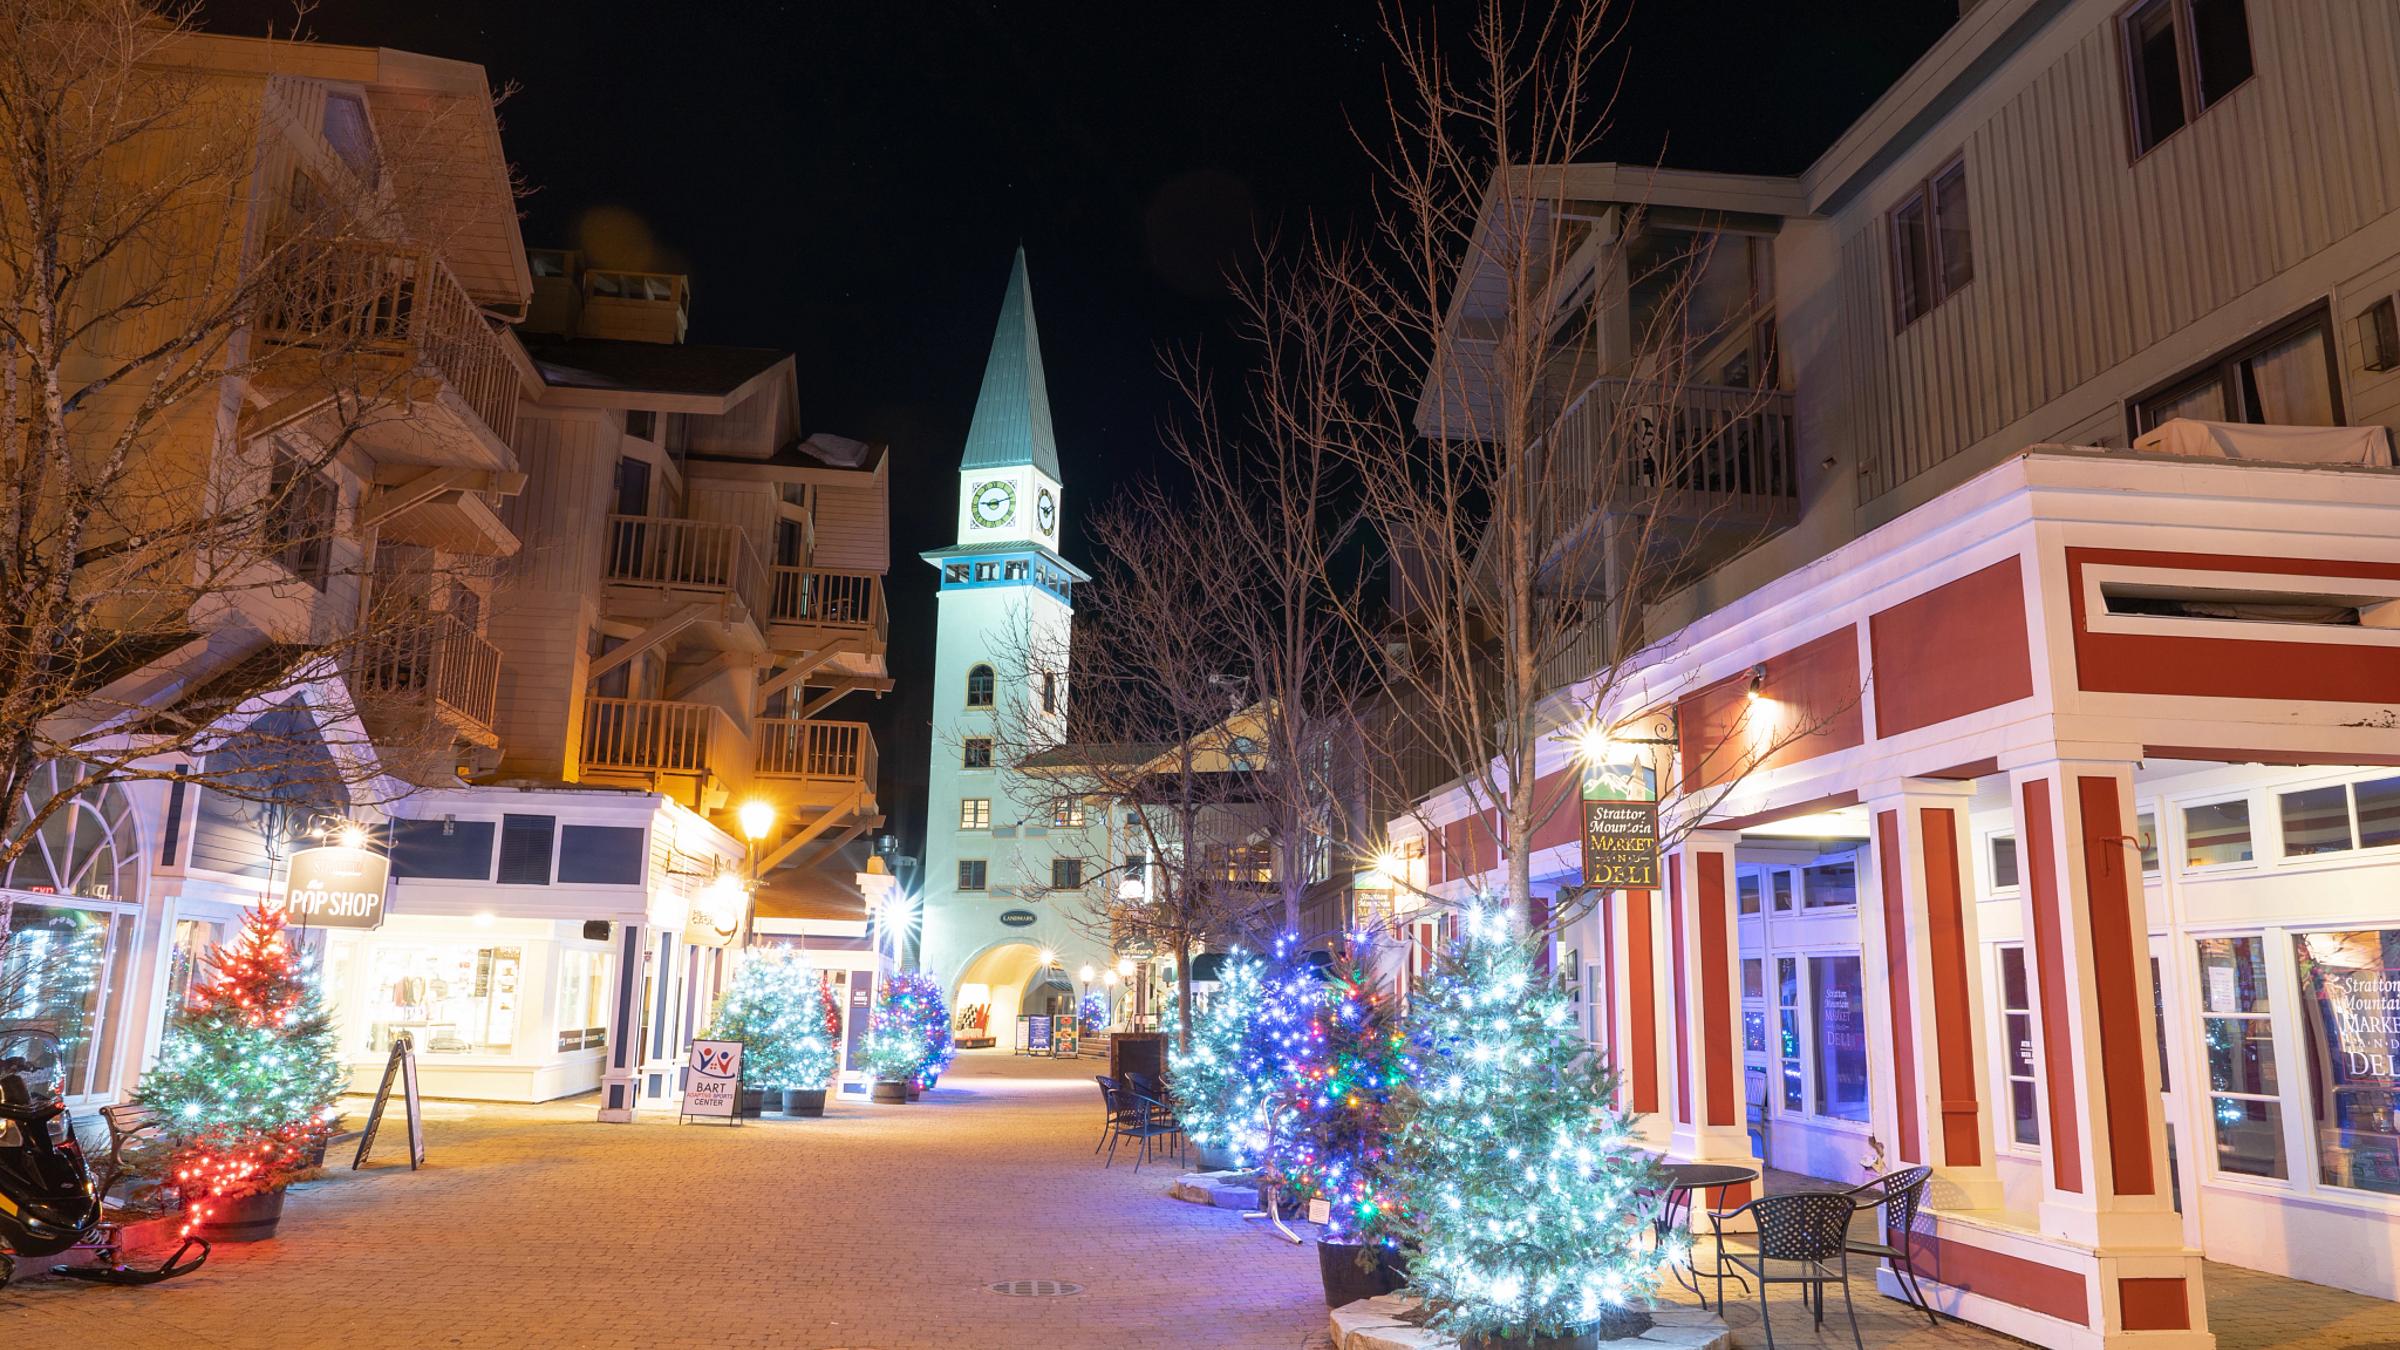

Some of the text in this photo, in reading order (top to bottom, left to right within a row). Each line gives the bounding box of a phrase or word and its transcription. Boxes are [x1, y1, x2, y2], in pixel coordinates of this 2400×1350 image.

[1590, 820, 1652, 834] Mountain
[1590, 835, 1655, 851] MARKET
[1593, 864, 1651, 884] DELI
[289, 889, 379, 917] POP SHOP
[2344, 977, 2400, 994] Stratton
[2343, 994, 2400, 1011] Mountai
[2342, 1013, 2400, 1034] MARKE
[2347, 1051, 2400, 1077] DEL
[696, 1082, 727, 1093] BART
[694, 1098, 724, 1107] CENTER
